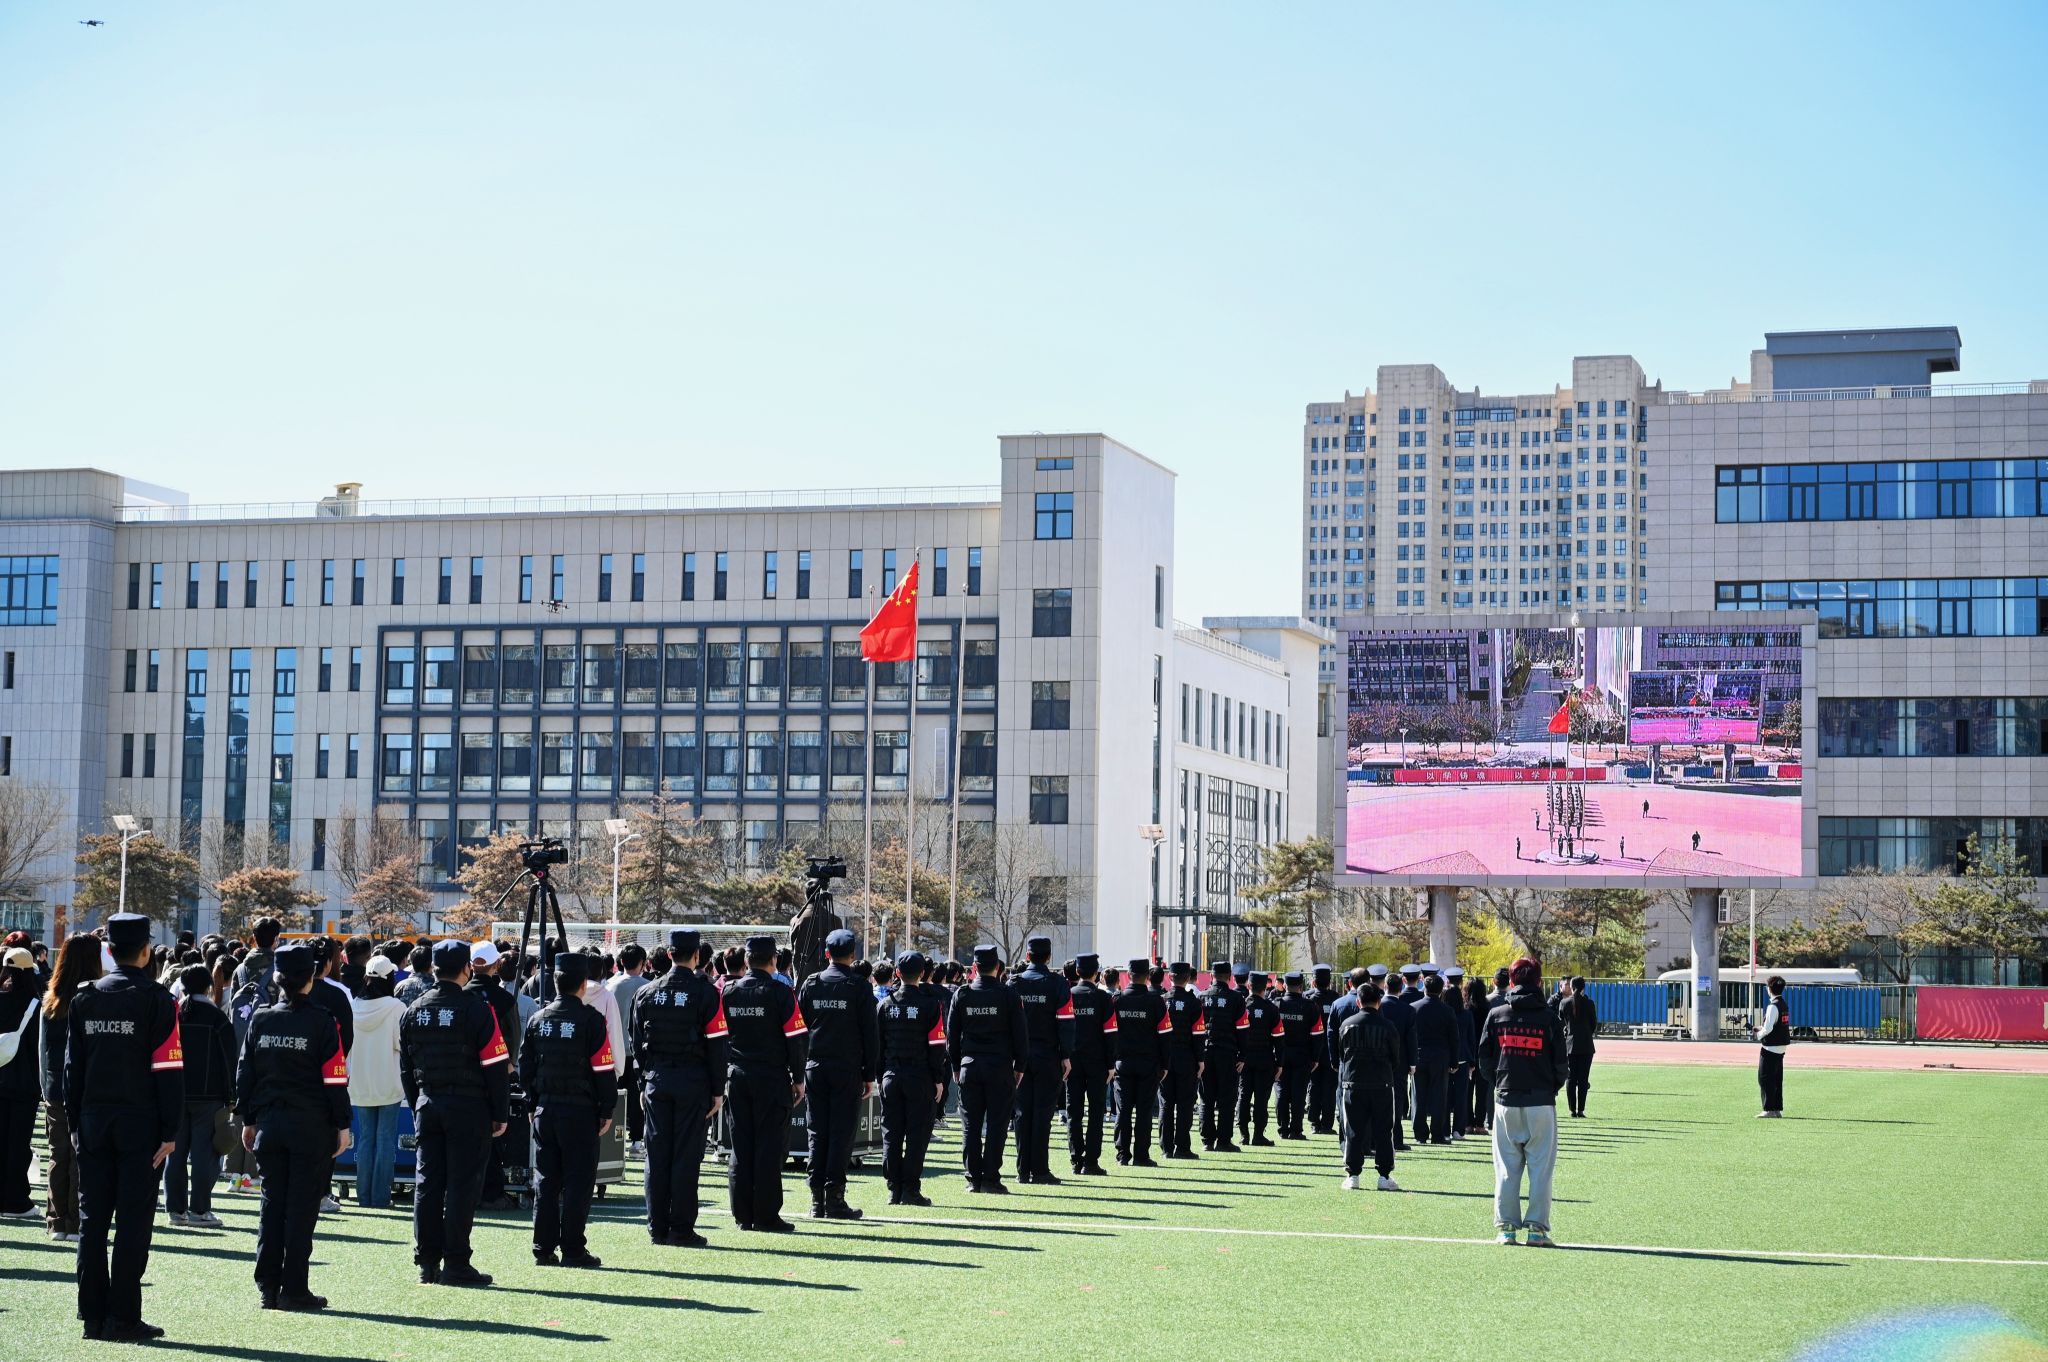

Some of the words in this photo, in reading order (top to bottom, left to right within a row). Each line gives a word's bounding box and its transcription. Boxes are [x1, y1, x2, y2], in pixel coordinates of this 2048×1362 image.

[654, 991, 688, 1007] 特警
[812, 999, 848, 1010] 警POLICE察
[416, 1008, 454, 1026] 特警
[728, 1006, 765, 1017] 警POLICE察
[890, 1007, 919, 1019] 特警
[966, 1006, 998, 1016] 警POLICE察
[84, 1020, 135, 1036] 警POLICE察
[538, 1021, 576, 1039] 特警
[260, 1034, 308, 1051] 警POLICE察
